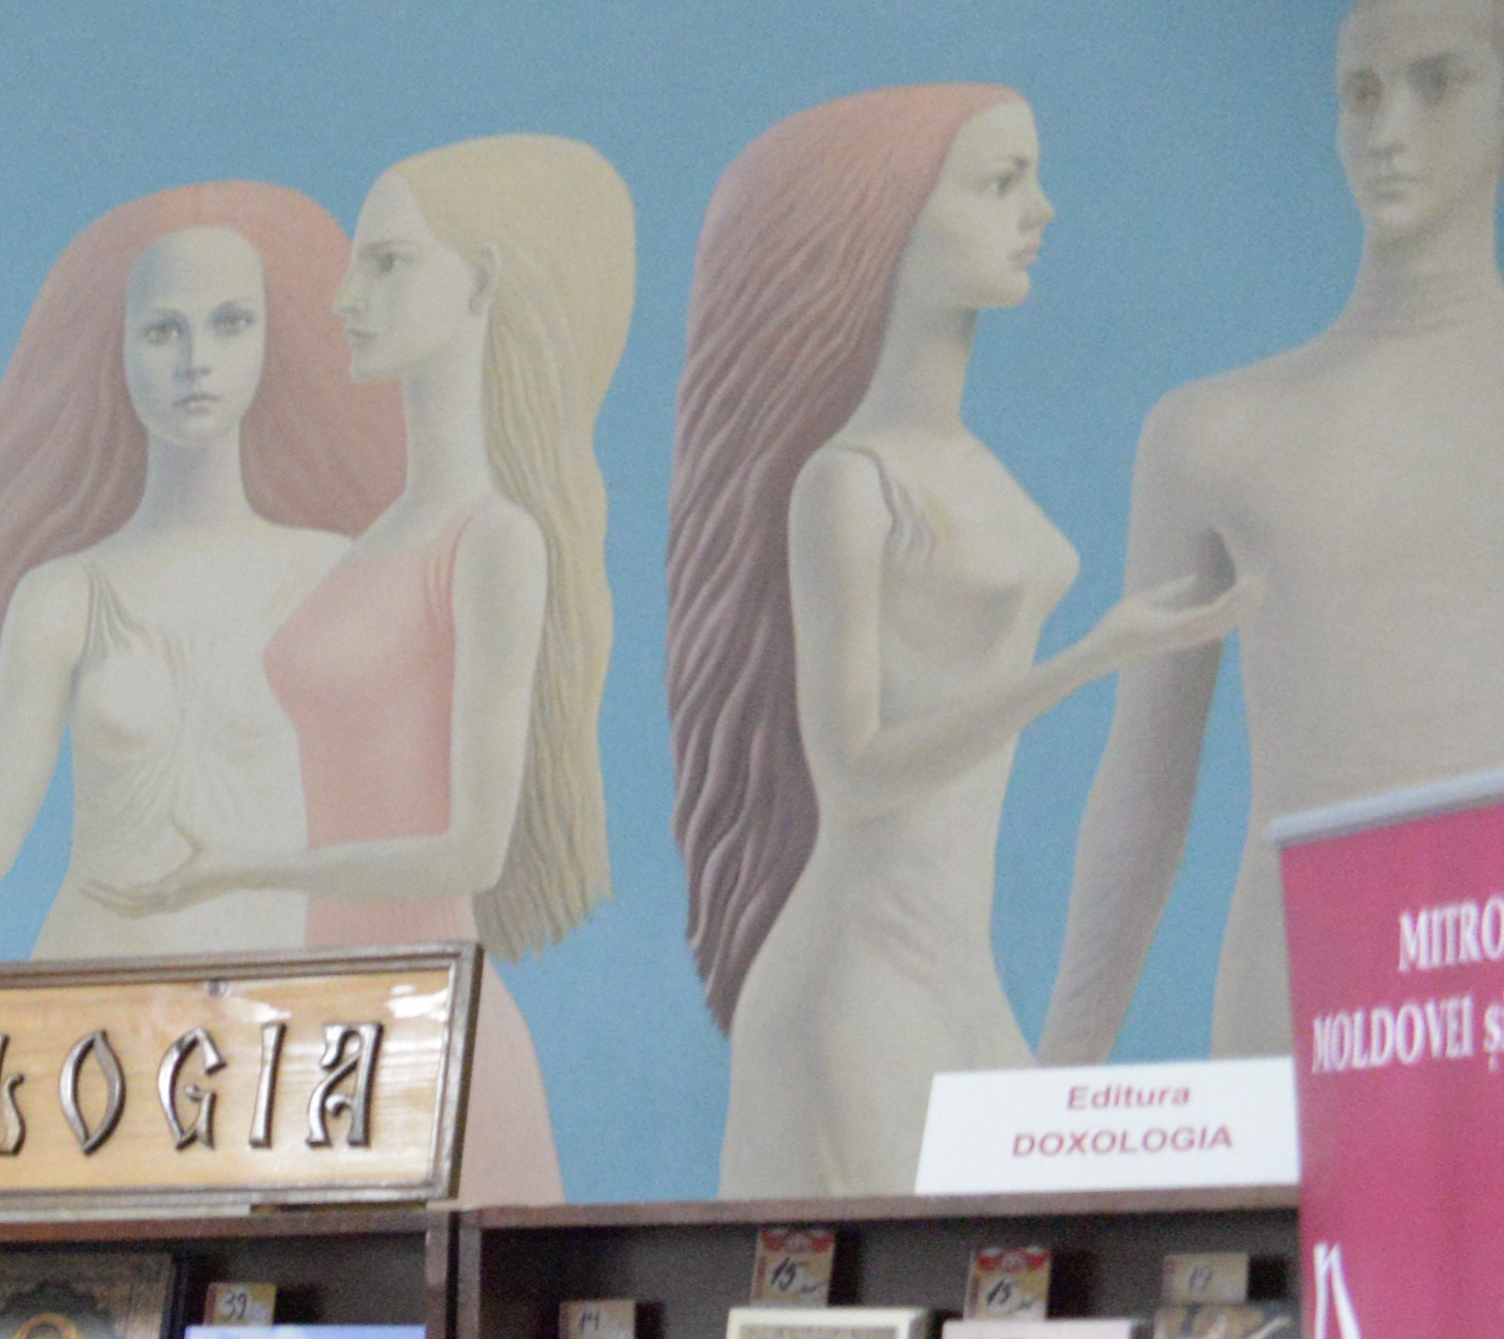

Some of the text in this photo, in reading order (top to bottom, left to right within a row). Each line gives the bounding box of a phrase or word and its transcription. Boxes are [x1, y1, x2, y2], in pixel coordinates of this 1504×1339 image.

[1311, 993, 1474, 1074] MOLDOVEI
[1066, 1083, 1191, 1111] Editura
[1012, 1124, 1233, 1158] DOXOLOGIA
